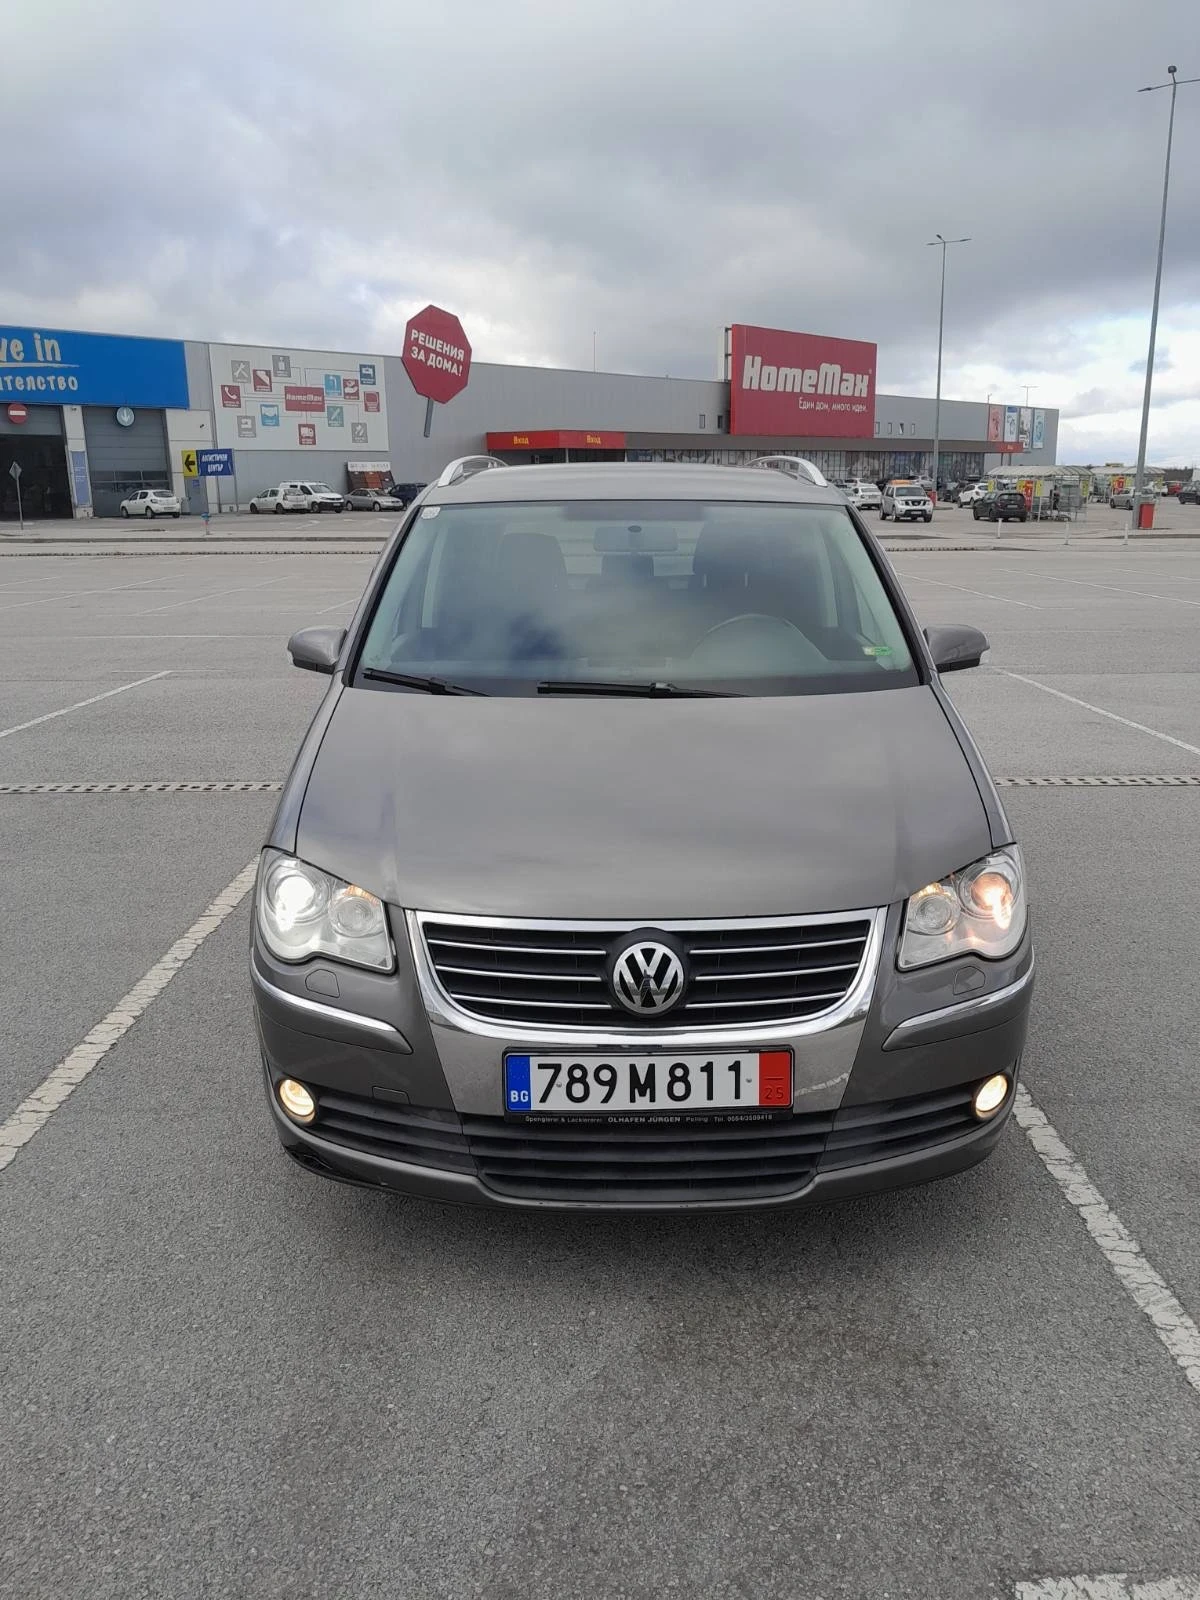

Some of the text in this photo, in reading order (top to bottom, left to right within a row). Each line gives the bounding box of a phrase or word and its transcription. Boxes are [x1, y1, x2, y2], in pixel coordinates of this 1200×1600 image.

[33, 332, 61, 361] in
[411, 329, 465, 362] РЕШЕНИЯ
[410, 346, 463, 377] ЗА ДОМА!
[0, 375, 79, 391] телство
[742, 355, 869, 398] HomeMax
[798, 397, 815, 409] Един
[513, 435, 529, 445] Вход
[586, 434, 601, 445] Вход
[537, 1060, 741, 1103] 789 M 811
[510, 1090, 529, 1103] BG
[764, 1085, 784, 1100] 25
